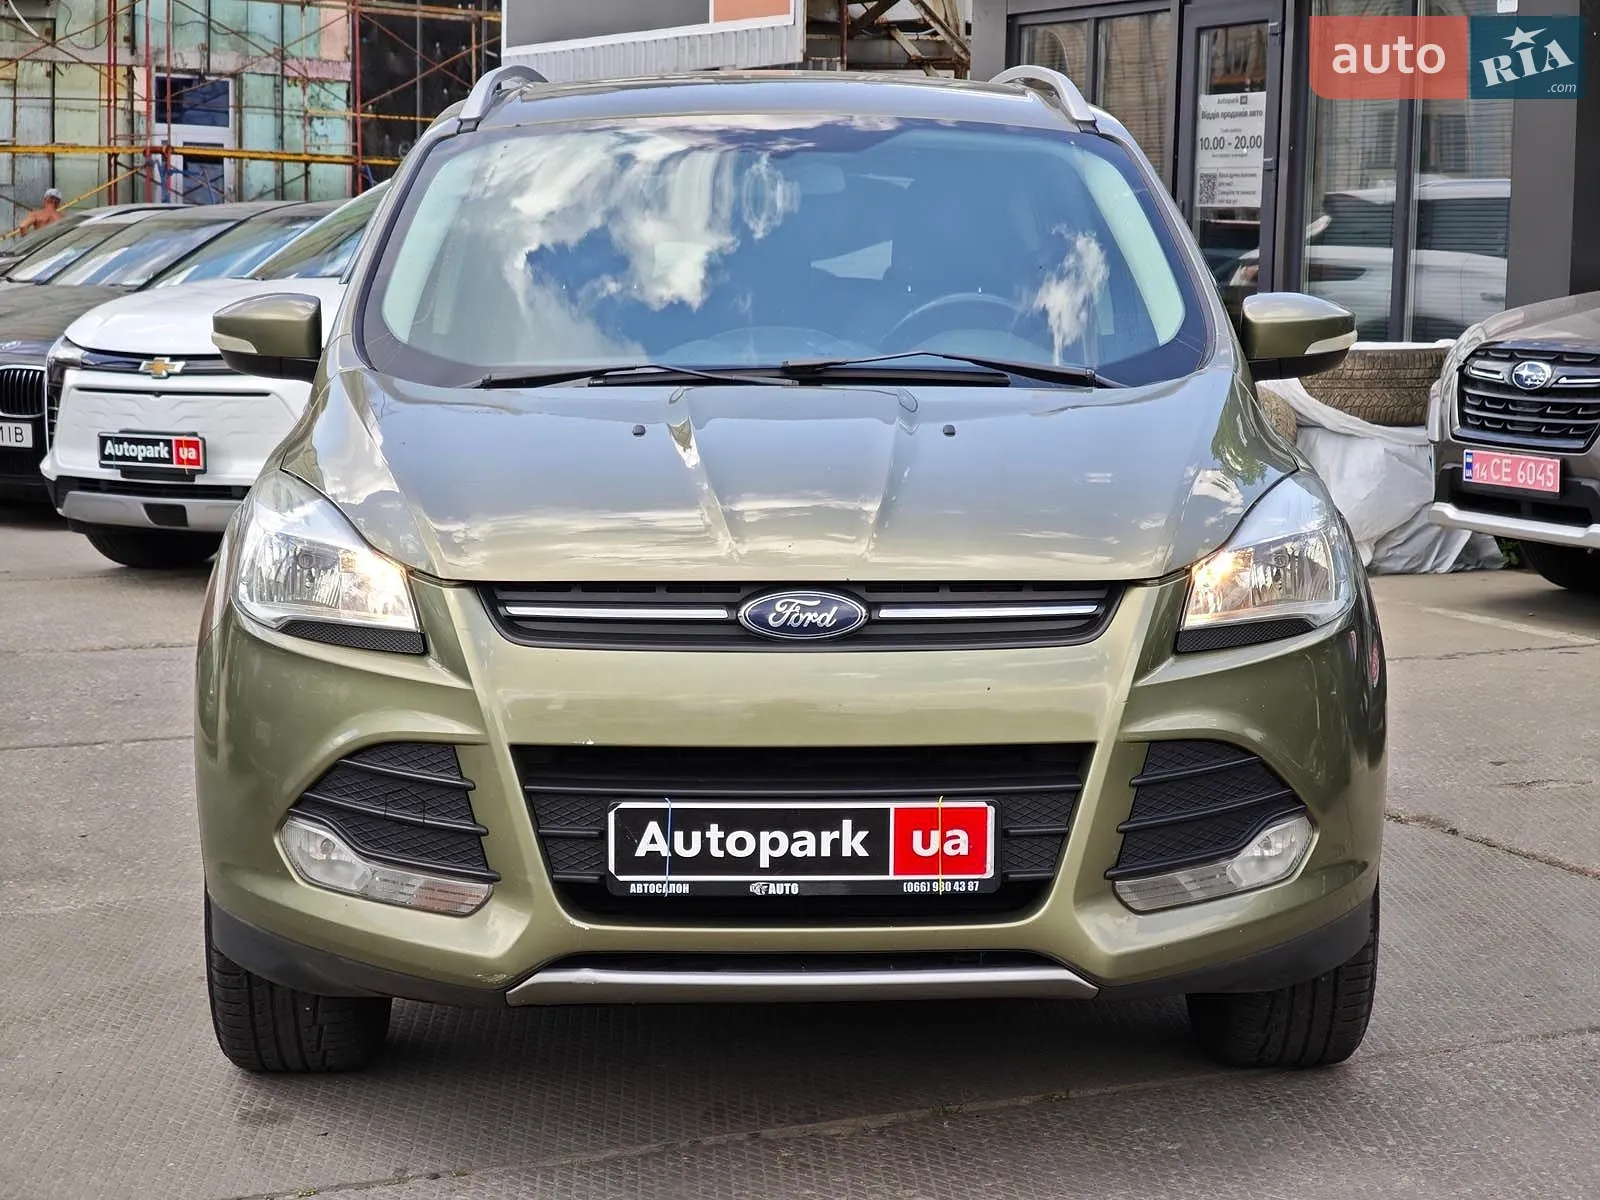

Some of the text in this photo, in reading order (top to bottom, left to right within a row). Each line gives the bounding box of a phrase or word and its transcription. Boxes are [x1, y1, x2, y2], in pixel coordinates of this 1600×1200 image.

[1200, 136, 1225, 150] 10.00
[1234, 135, 1262, 149] 20.00
[104, 439, 197, 461] Autopark ua
[1517, 460, 1554, 487] 6045
[768, 598, 838, 628] Ford
[634, 819, 969, 868] Autopark ua
[630, 883, 690, 895] АВТОСАЛОН
[768, 883, 799, 895] AUTO
[903, 881, 931, 892] (066)
[953, 881, 966, 892] 43
[967, 880, 980, 892] 87
